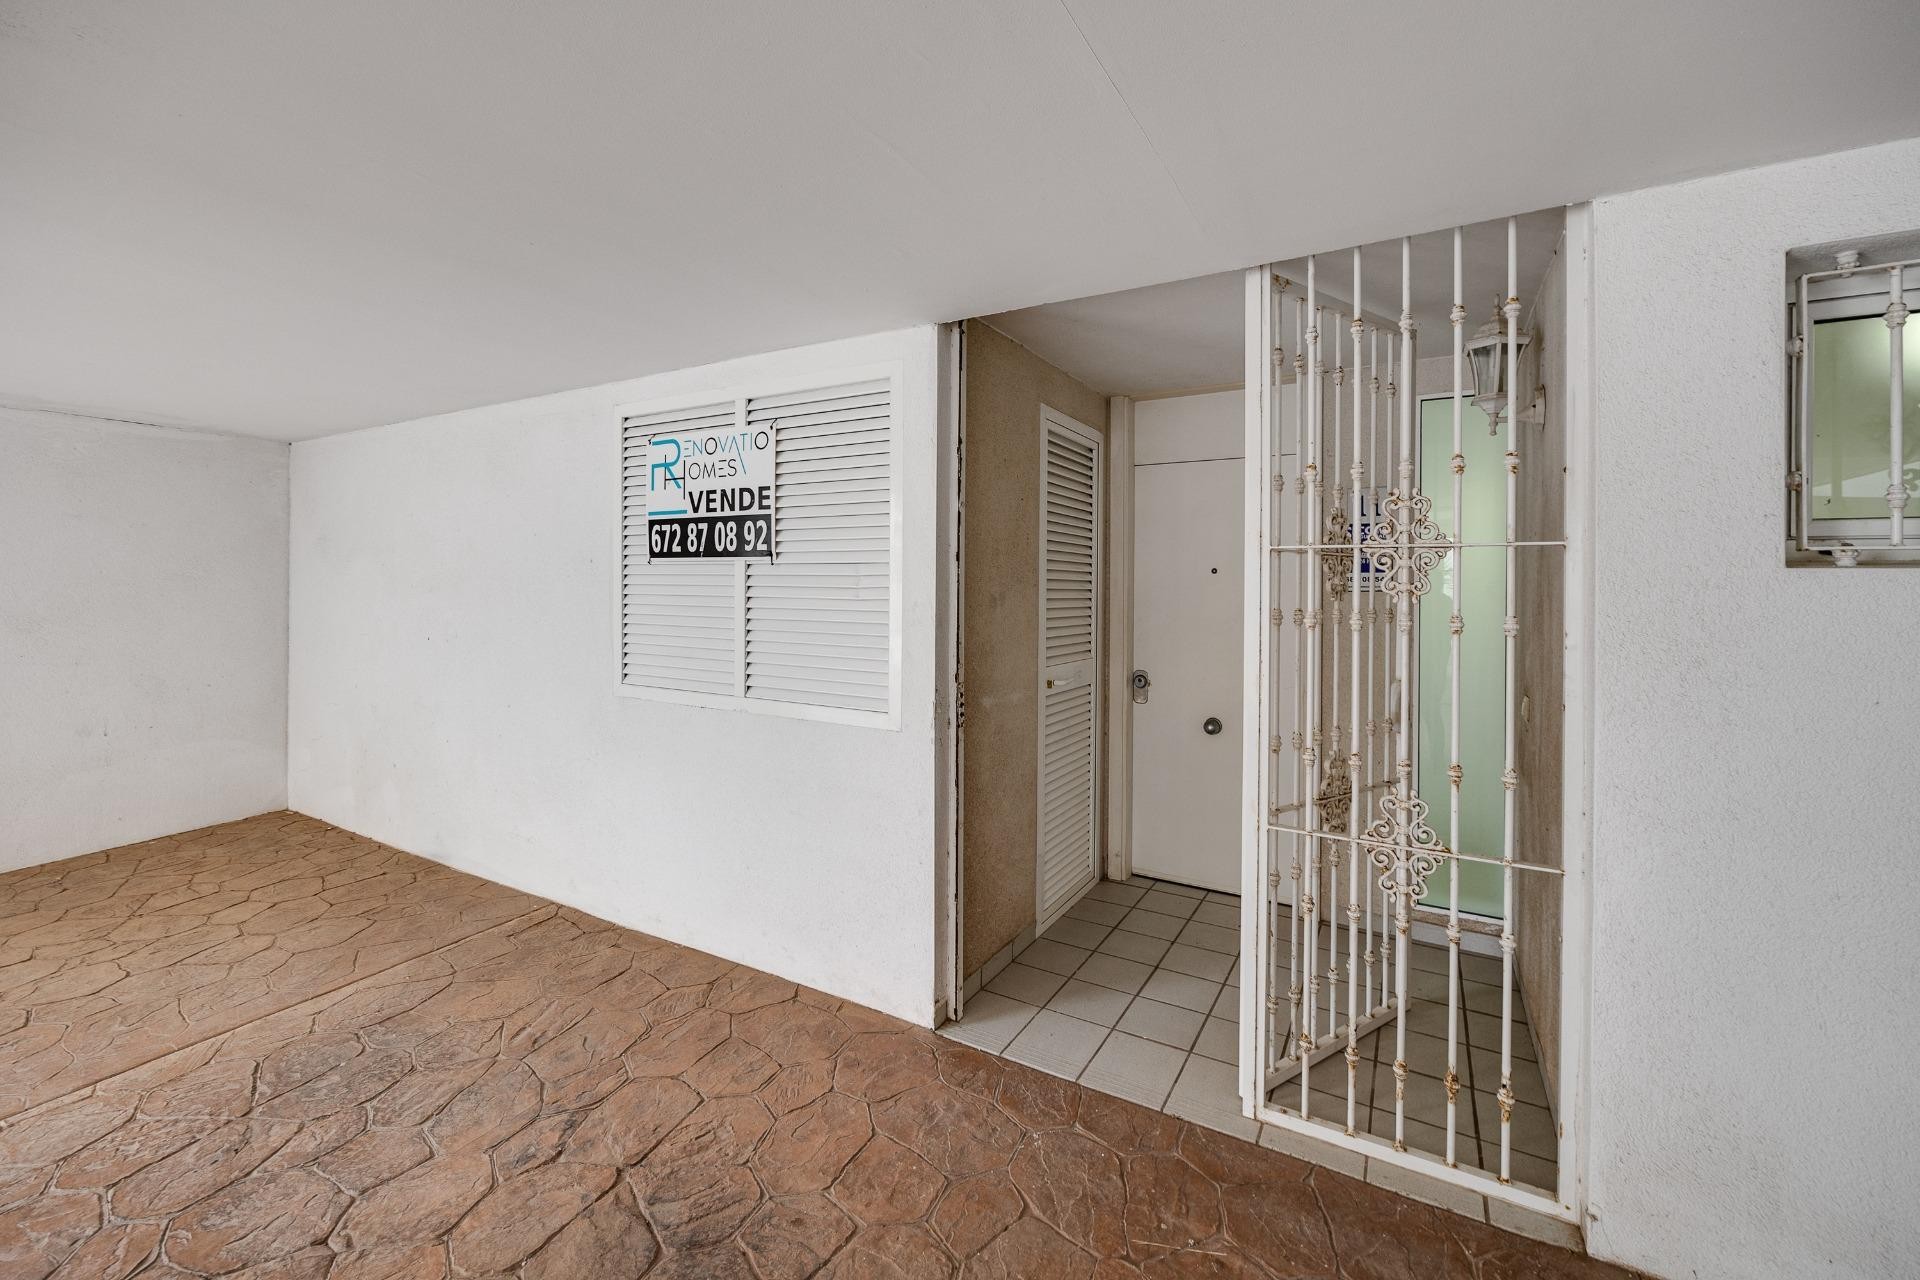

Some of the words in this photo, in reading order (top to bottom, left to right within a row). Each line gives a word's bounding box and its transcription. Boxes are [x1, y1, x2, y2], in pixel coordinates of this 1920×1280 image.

[651, 431, 769, 490] RENOVATIO
[664, 454, 737, 500] HOMES
[688, 486, 771, 513] VENDE
[651, 524, 681, 553] 672
[687, 522, 708, 552] 87
[714, 521, 737, 552] 08
[743, 520, 767, 551] 92
